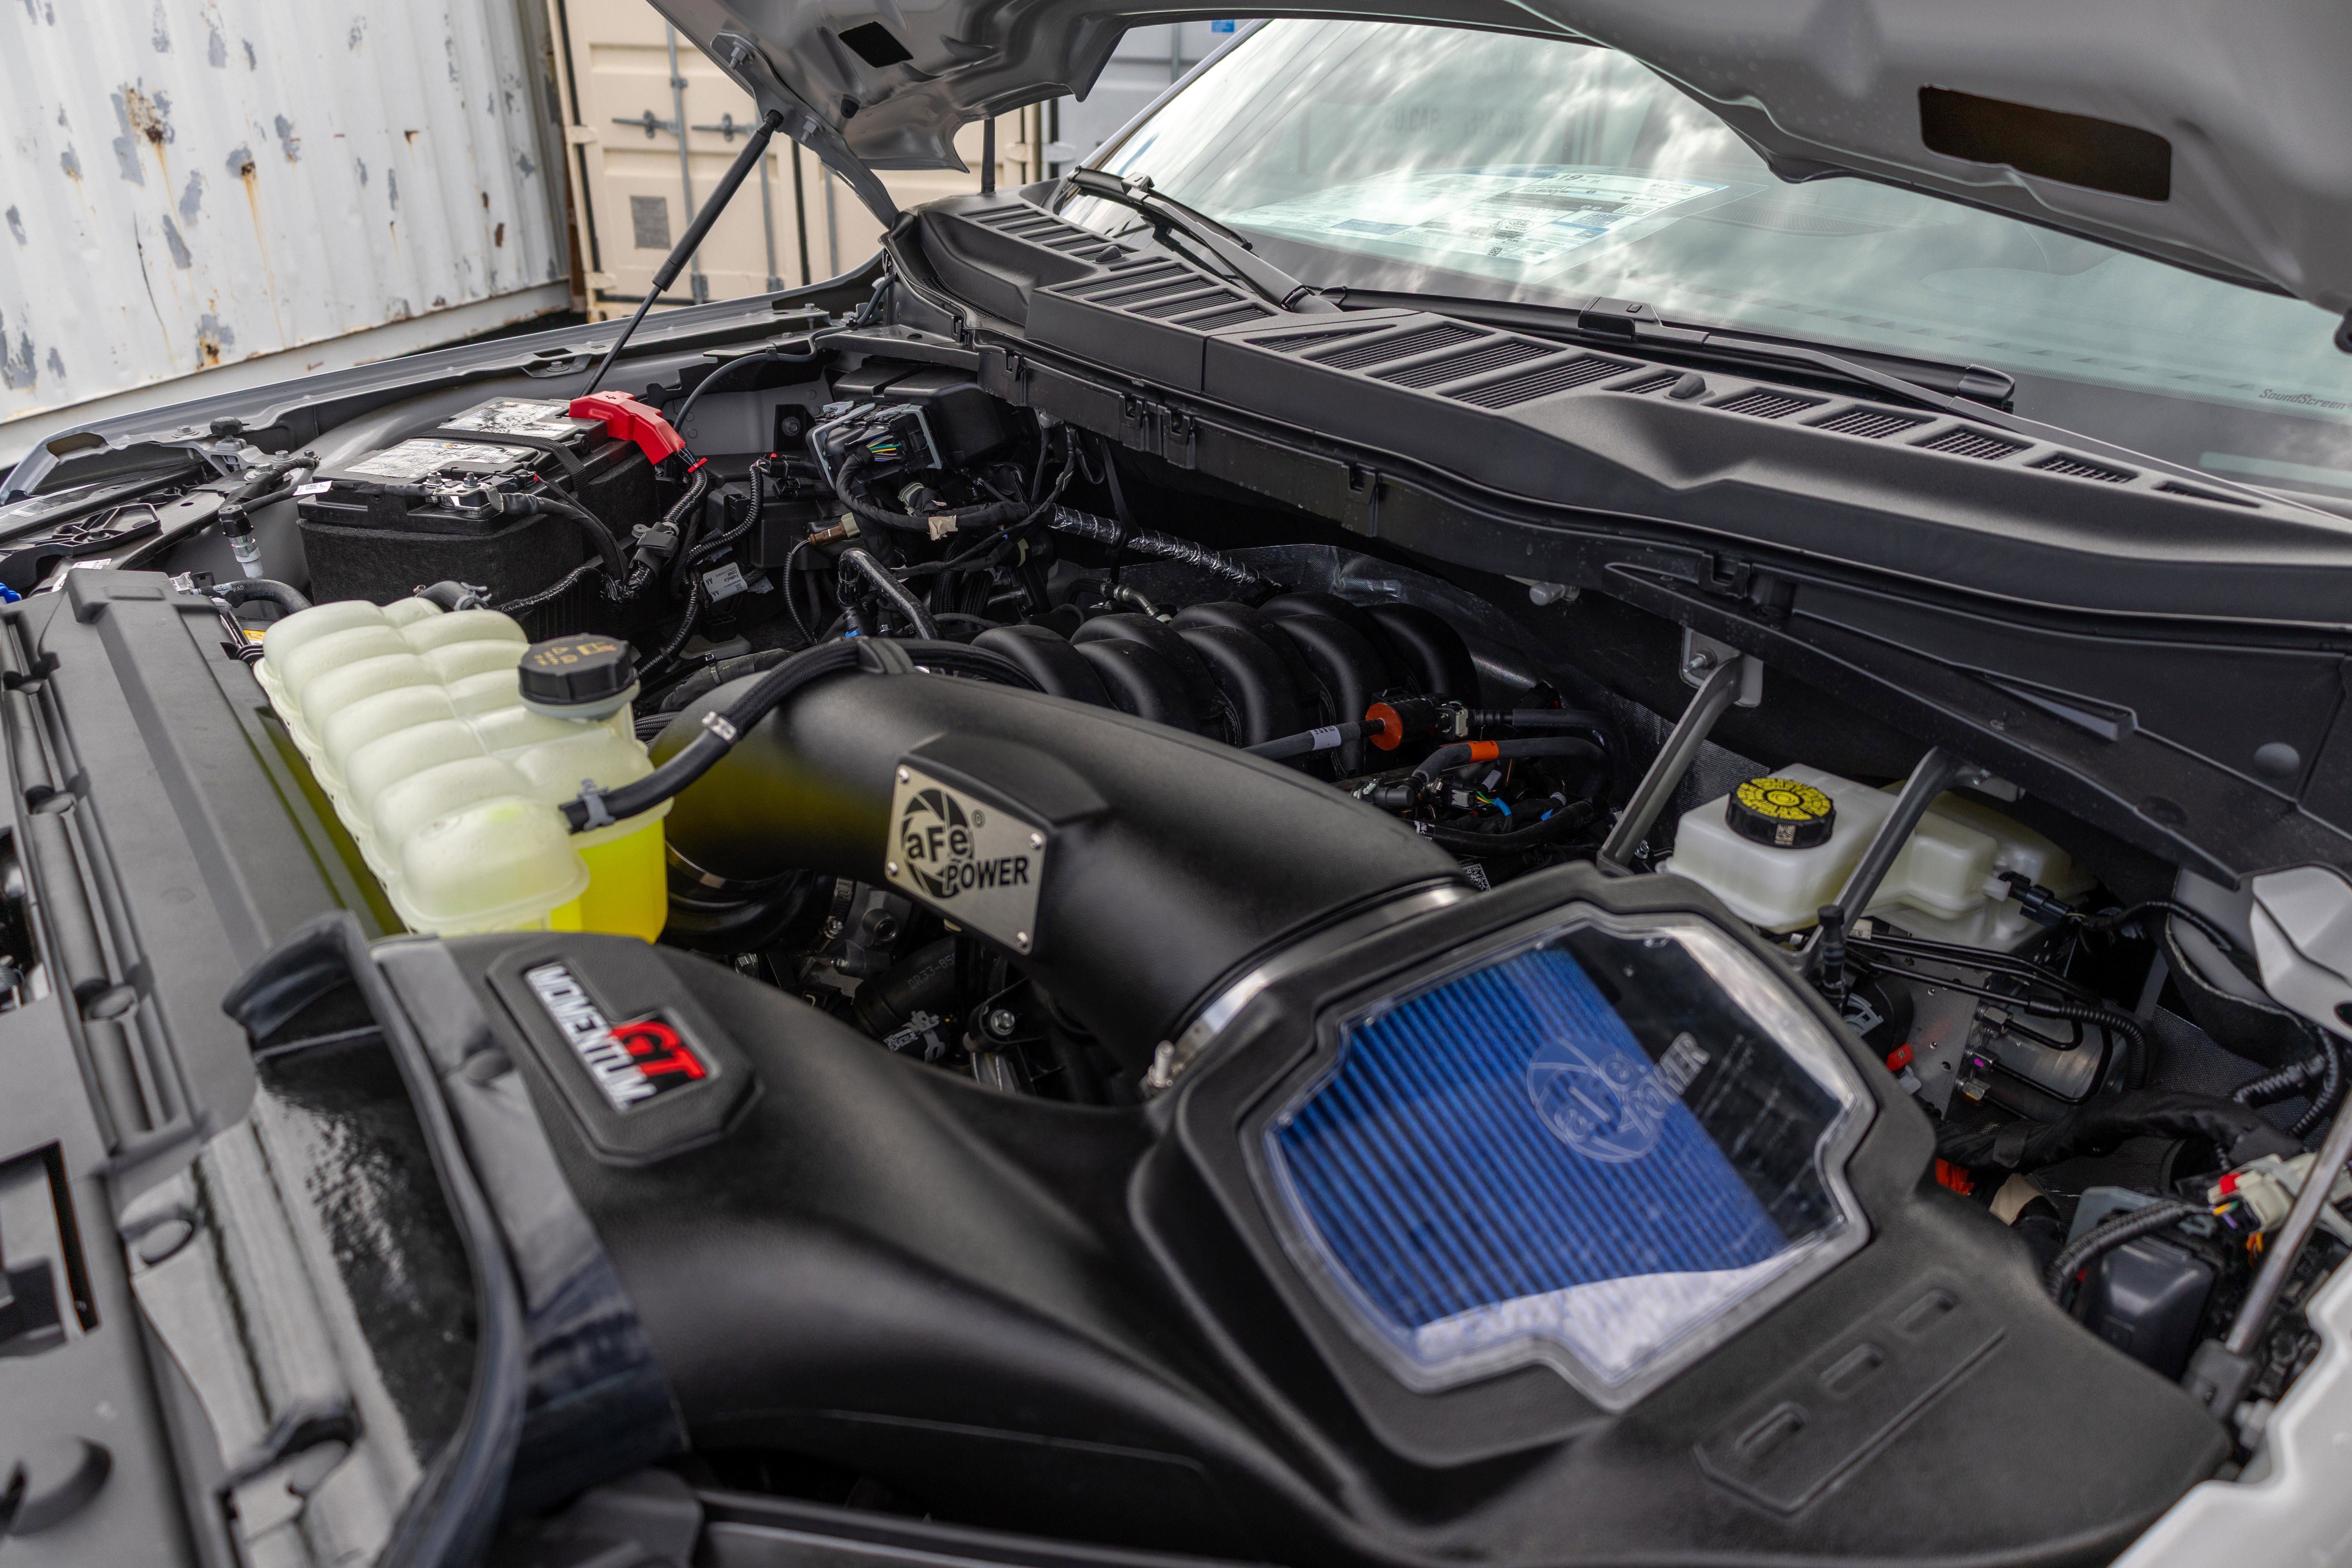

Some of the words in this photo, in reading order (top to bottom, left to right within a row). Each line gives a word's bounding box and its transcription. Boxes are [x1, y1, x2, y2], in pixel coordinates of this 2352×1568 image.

[705, 577, 713, 585] AA
[724, 573, 739, 582] FoMoCo
[907, 825, 969, 862] aFe
[944, 857, 1029, 892] POWER
[528, 964, 657, 1111] MOMENTUM
[612, 1020, 707, 1079] GT
